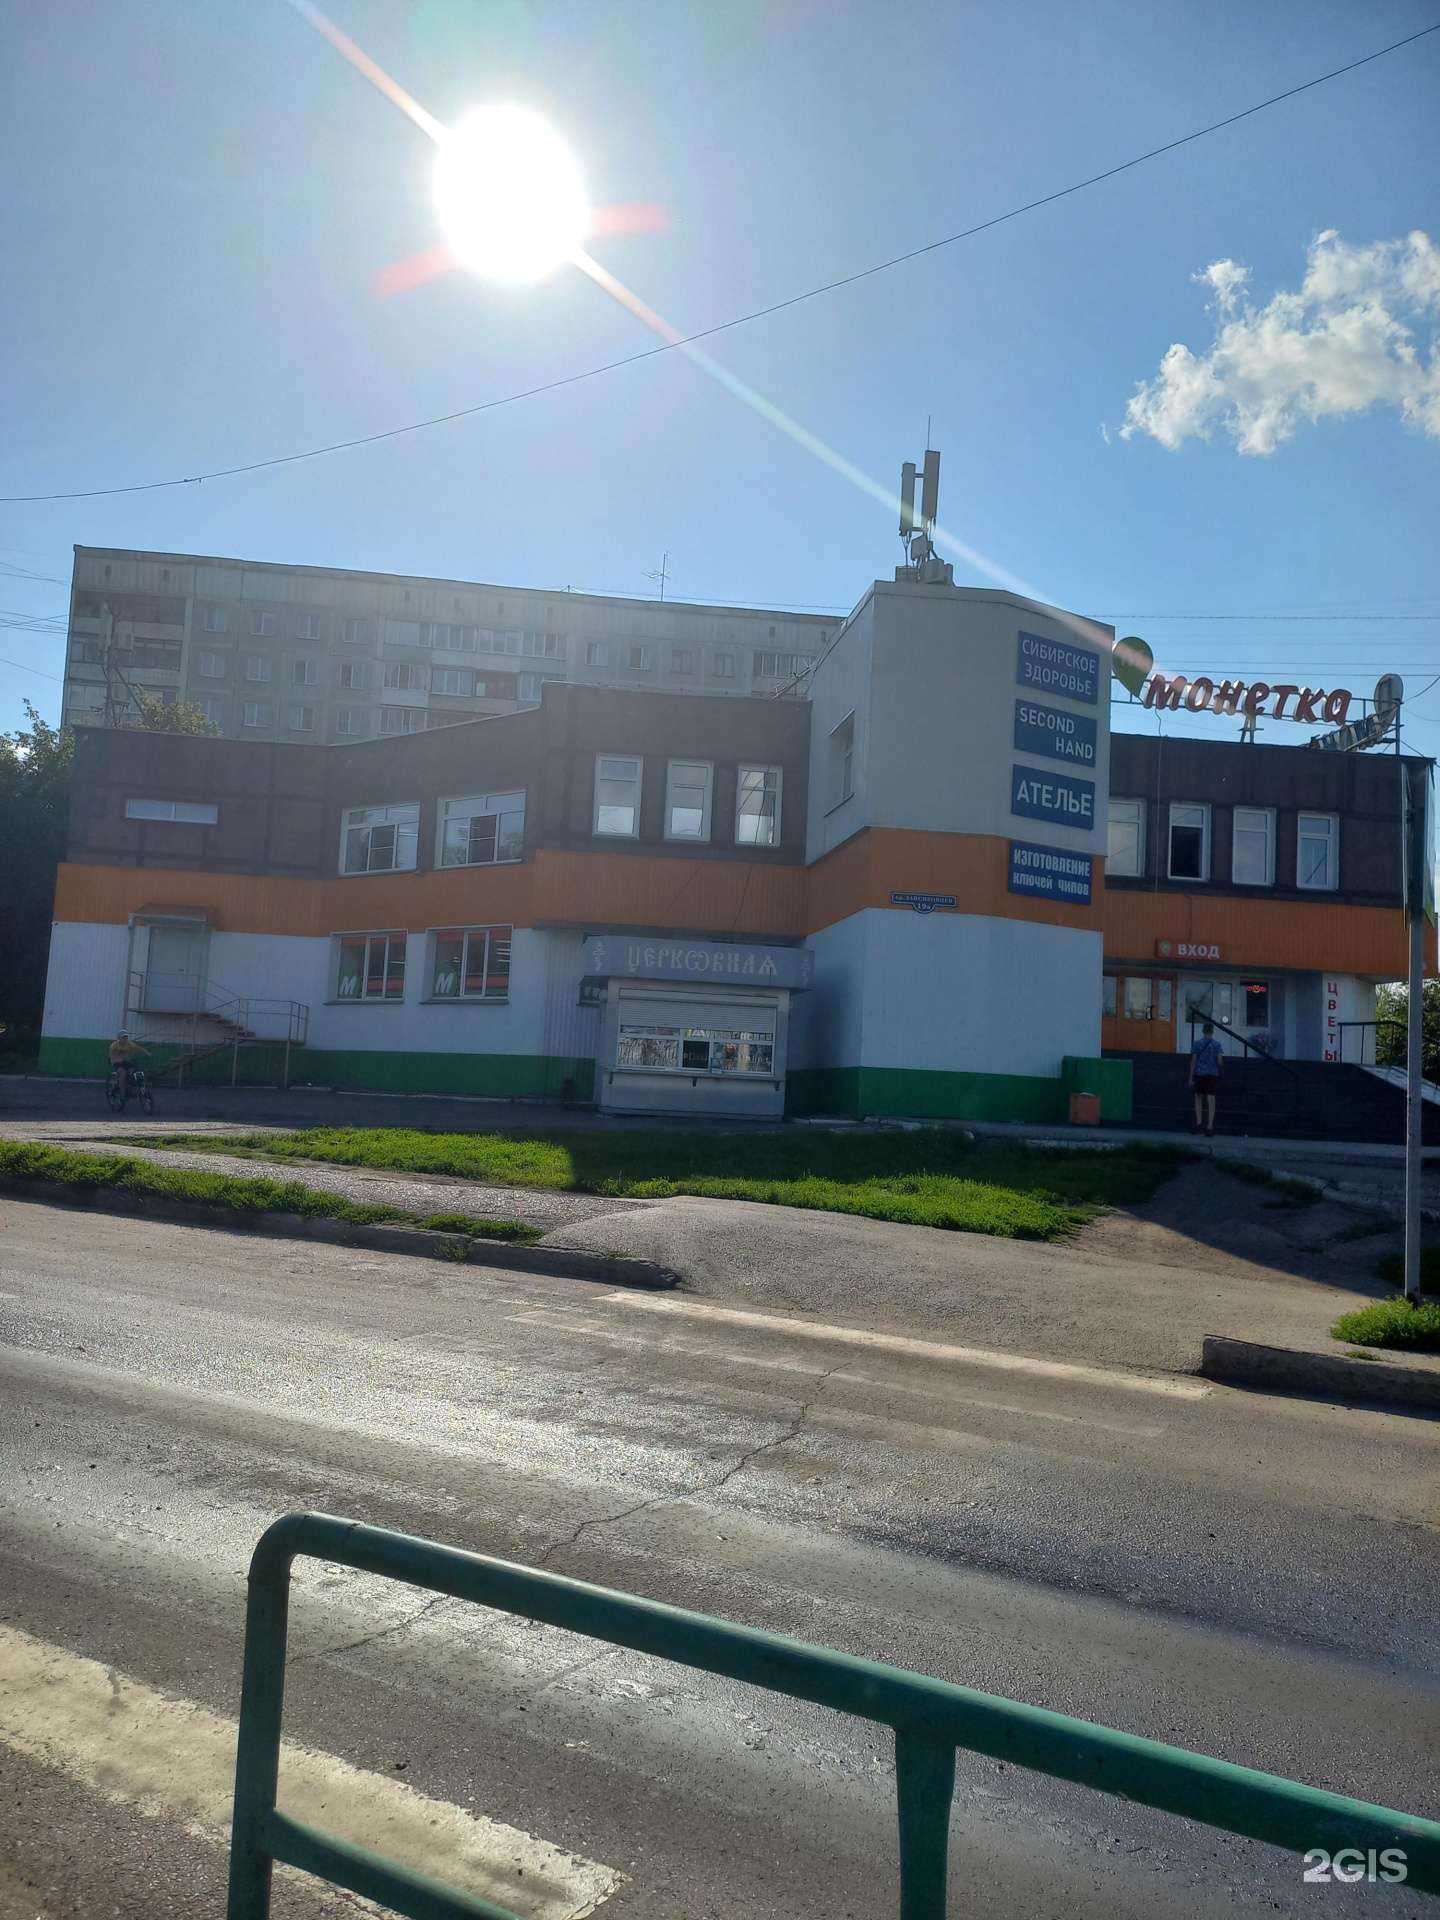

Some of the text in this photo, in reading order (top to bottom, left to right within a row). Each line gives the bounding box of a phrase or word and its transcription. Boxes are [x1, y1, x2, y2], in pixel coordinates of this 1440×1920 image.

[1022, 639, 1096, 674] СИБИРСКОЕ
[1025, 662, 1092, 695] ЗДОРОВЬЕ
[1020, 707, 1075, 734] SECOND
[1056, 737, 1093, 759] HAND
[1017, 779, 1092, 816] АТЕЛЬЕ
[1014, 848, 1090, 877] ИЗГОТОВЛЕНИЕ
[1178, 944, 1220, 959] ВХОД
[1325, 982, 1338, 1062] ЦВЕТЫ
